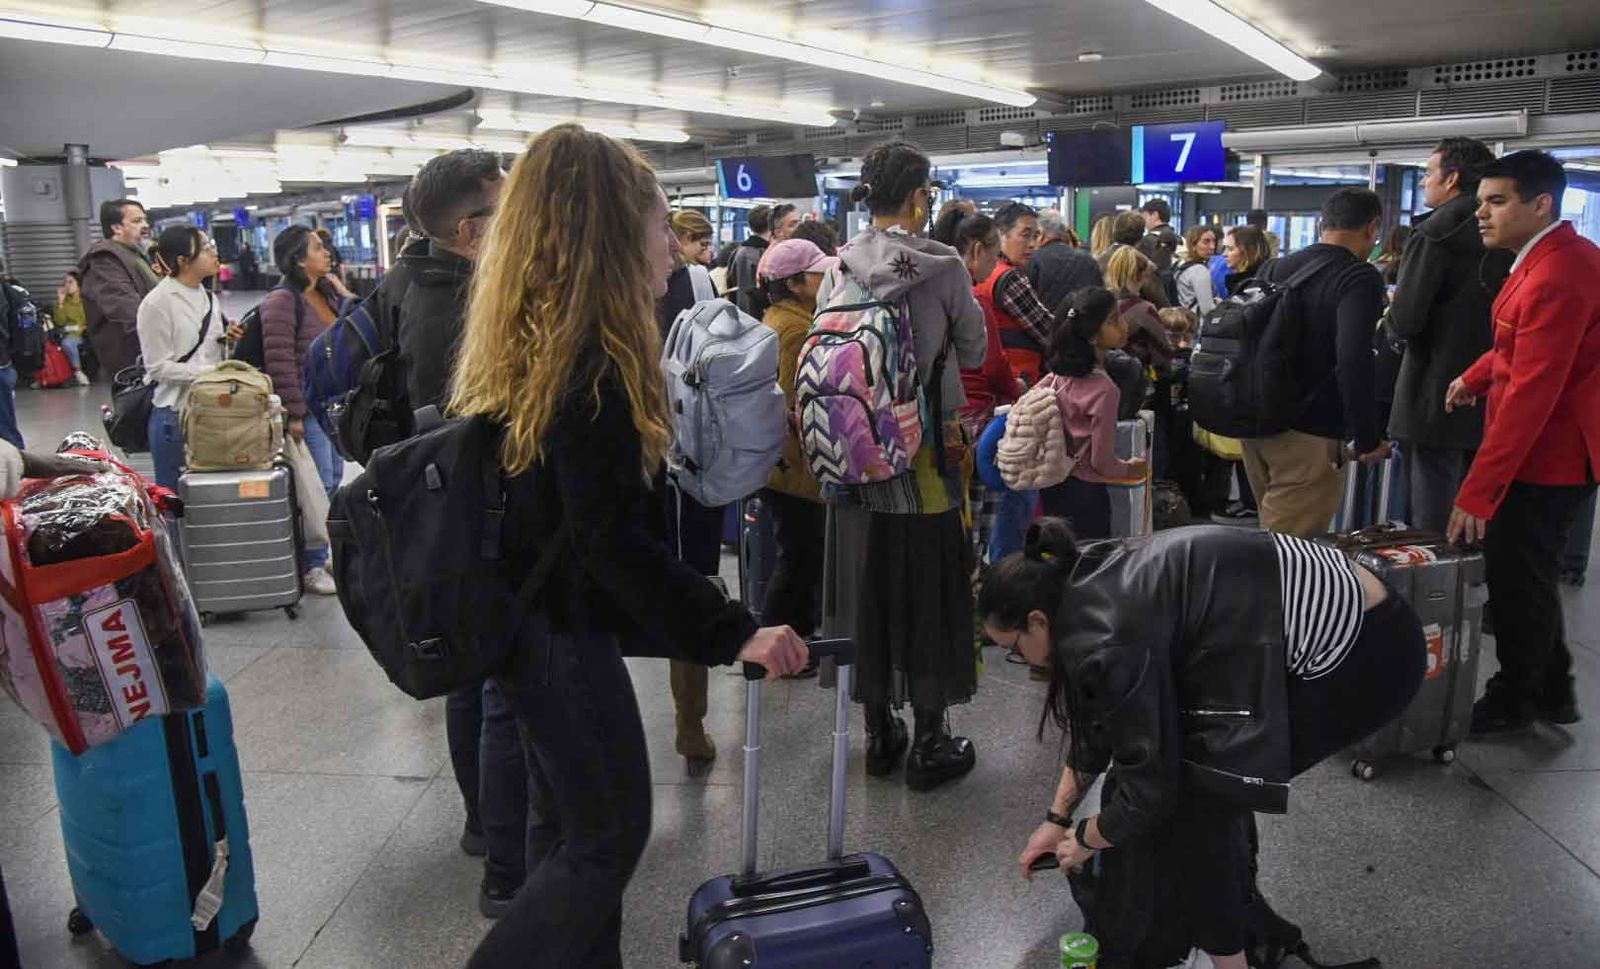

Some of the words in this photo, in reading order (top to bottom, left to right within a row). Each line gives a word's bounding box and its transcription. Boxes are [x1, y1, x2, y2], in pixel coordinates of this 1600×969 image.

[1170, 132, 1196, 172] 7
[737, 164, 752, 192] 6
[101, 608, 151, 722] NEJMA
